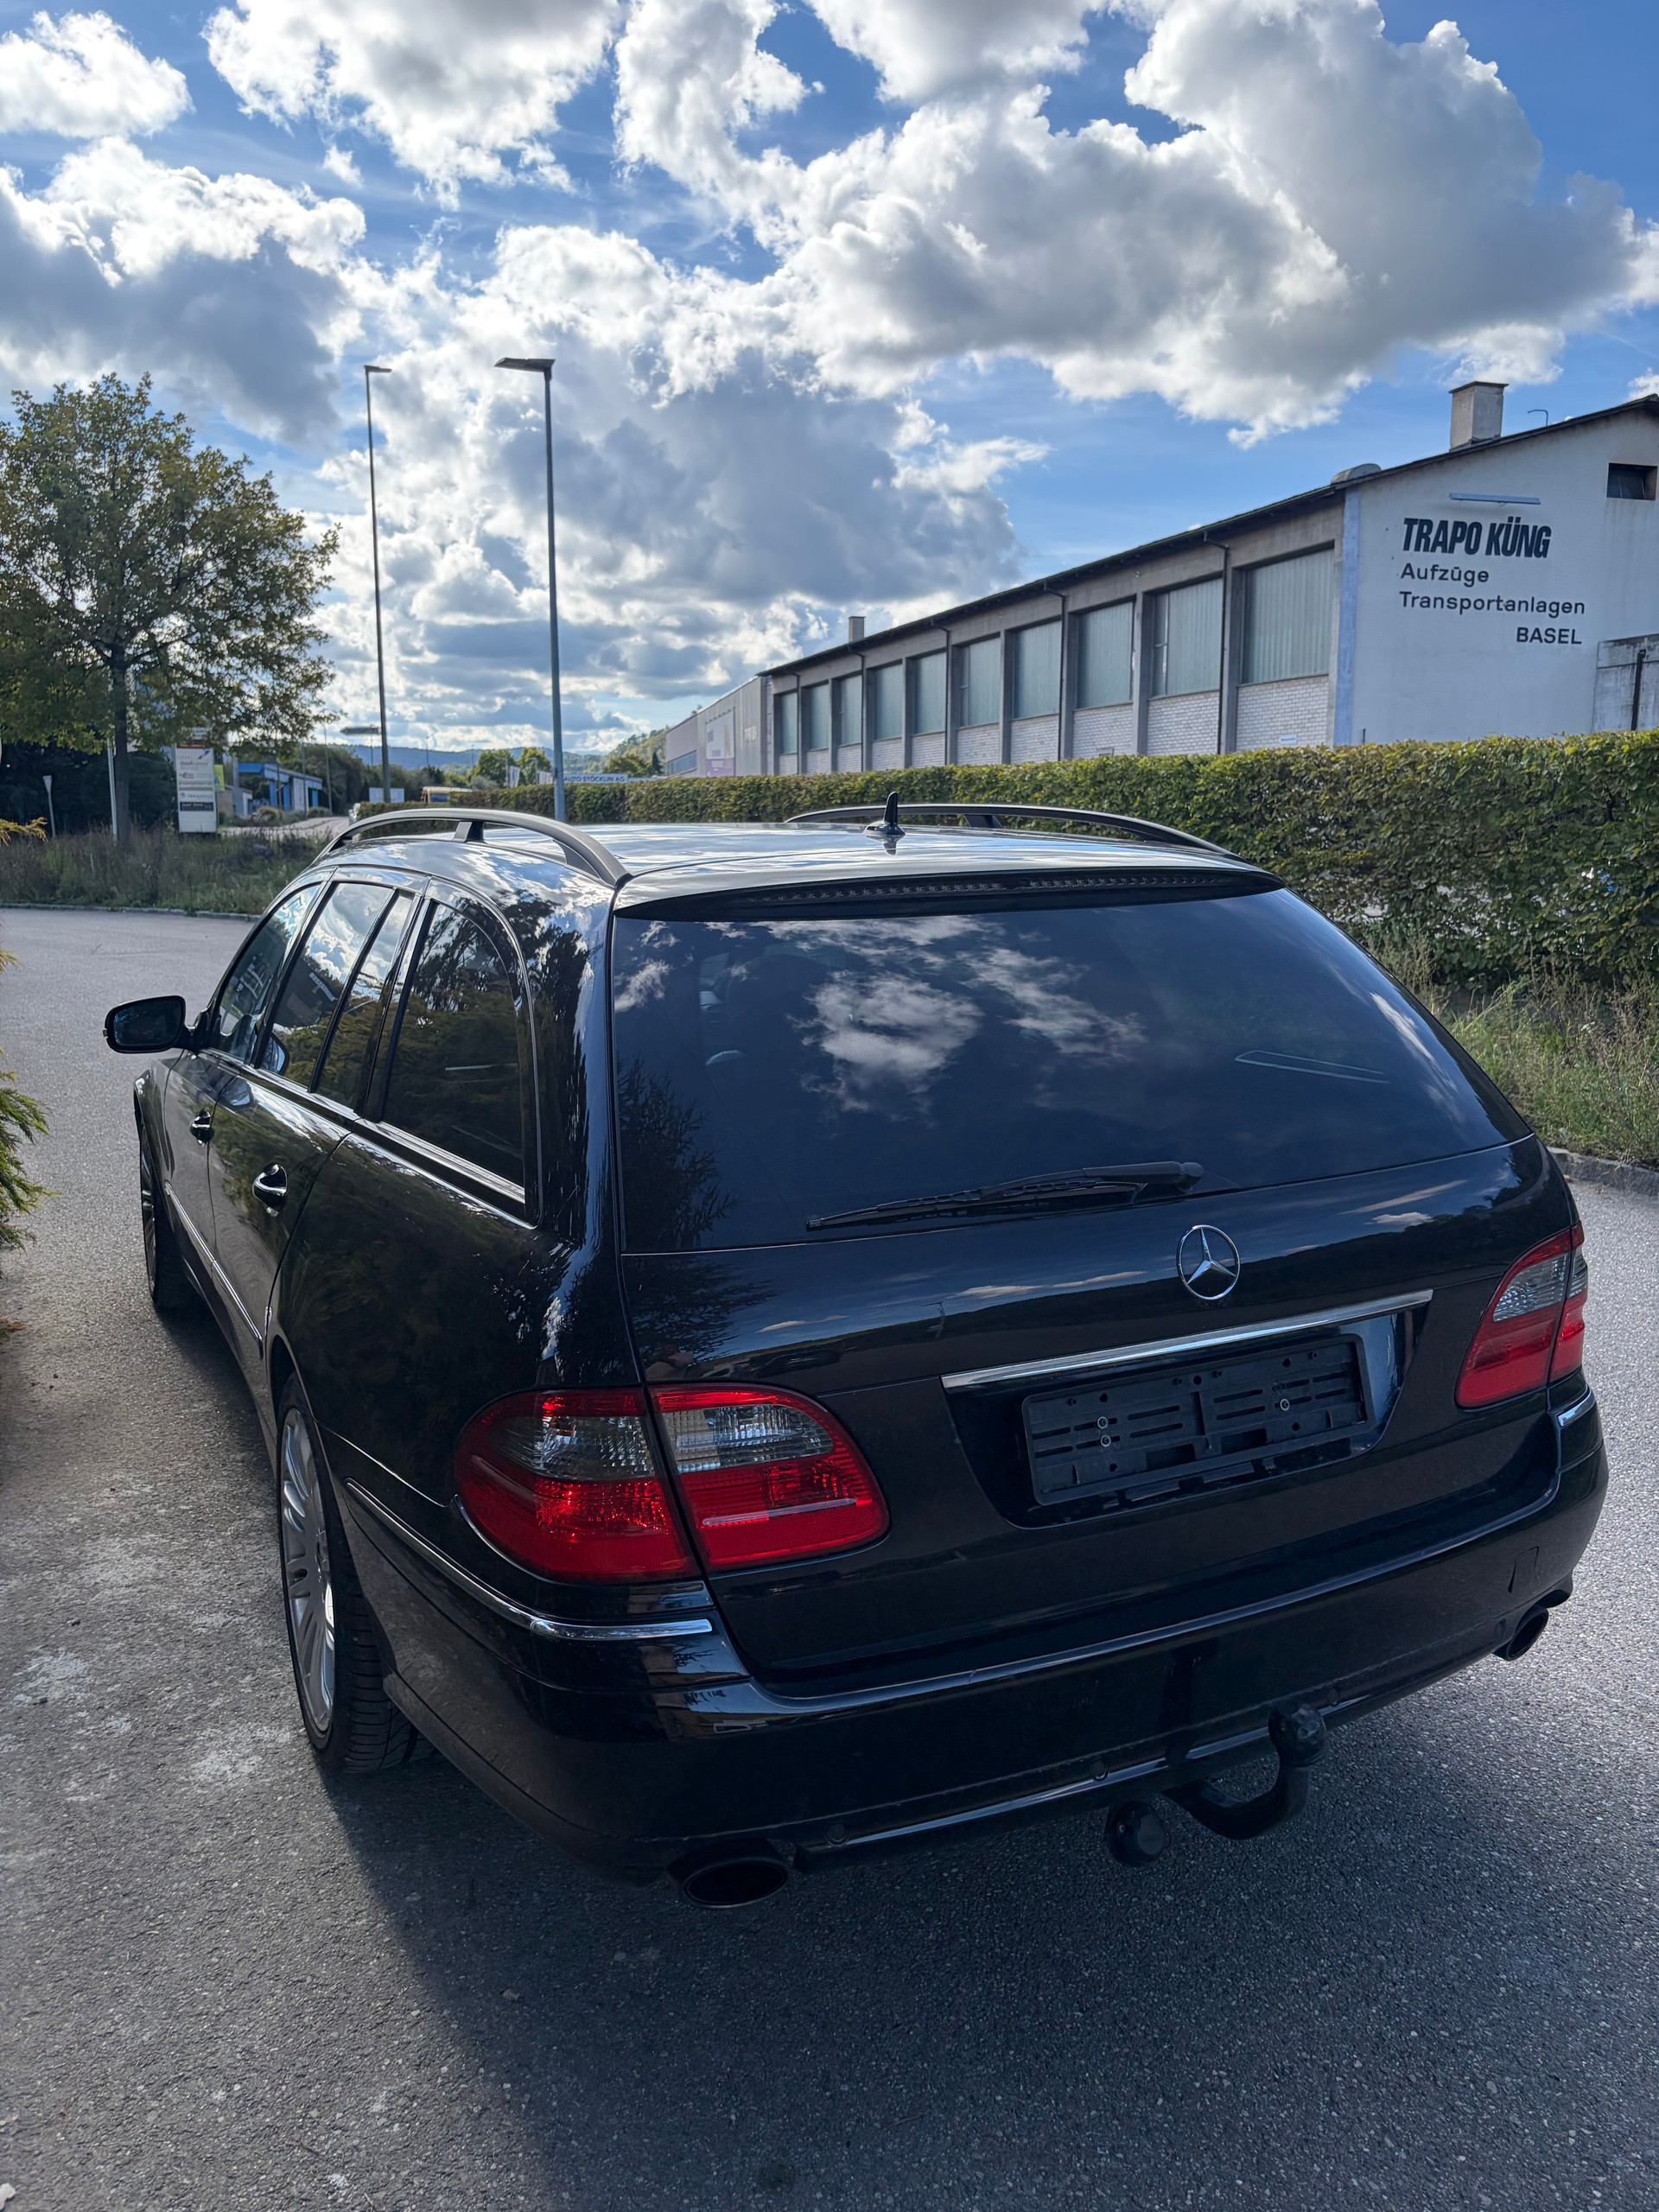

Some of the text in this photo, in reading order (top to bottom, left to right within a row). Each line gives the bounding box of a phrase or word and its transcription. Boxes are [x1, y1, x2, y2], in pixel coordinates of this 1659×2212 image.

[1402, 516, 1552, 558] TRAPO KÜNG
[1400, 563, 1490, 588] Aufzüge
[1399, 591, 1585, 619] Transportanlagen
[1516, 627, 1582, 645] BASEL
